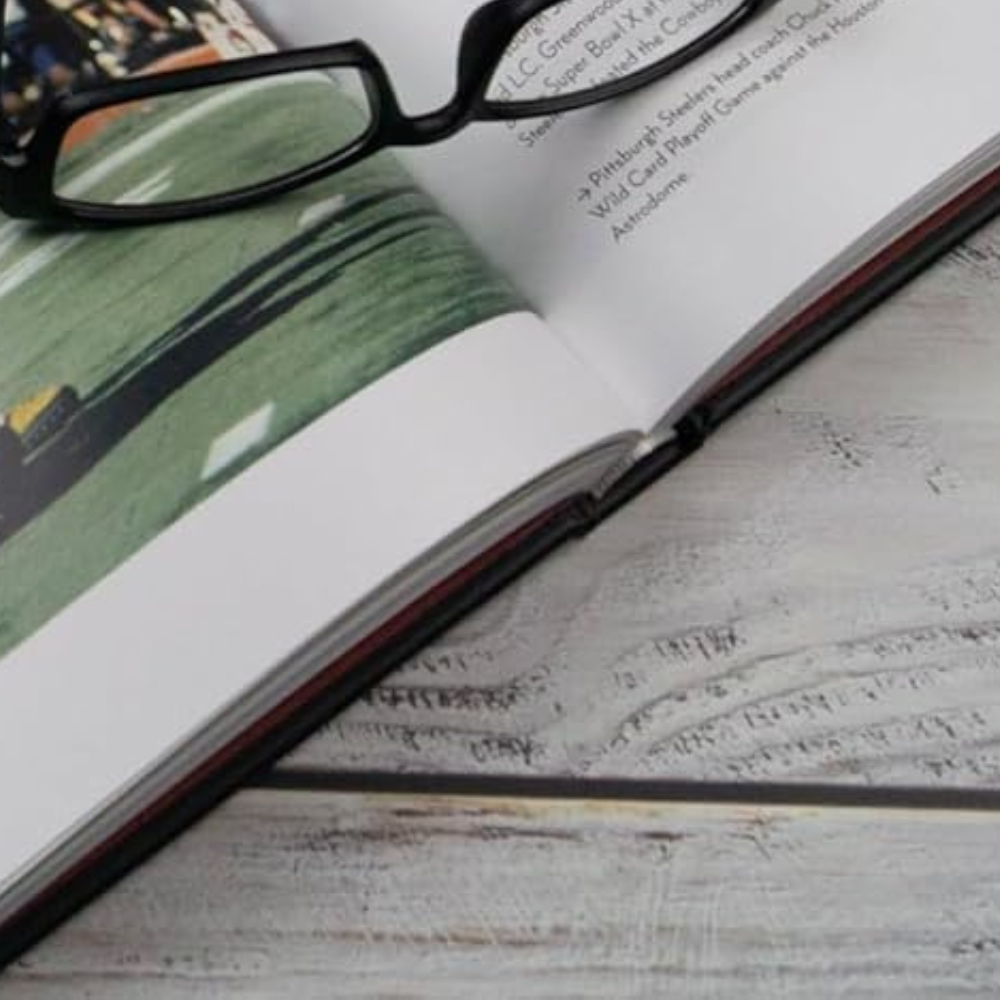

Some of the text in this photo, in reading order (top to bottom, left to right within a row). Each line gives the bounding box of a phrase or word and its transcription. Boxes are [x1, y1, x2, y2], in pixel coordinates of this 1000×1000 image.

[543, 20, 627, 97] Super Bowl
[588, 125, 662, 188] Pittsburgh
[657, 84, 717, 128] Steelers
[711, 52, 751, 85] head
[751, 28, 790, 59] coach
[588, 46, 808, 218] Wild Card Playoff Game against
[611, 173, 688, 243] Astrodome
